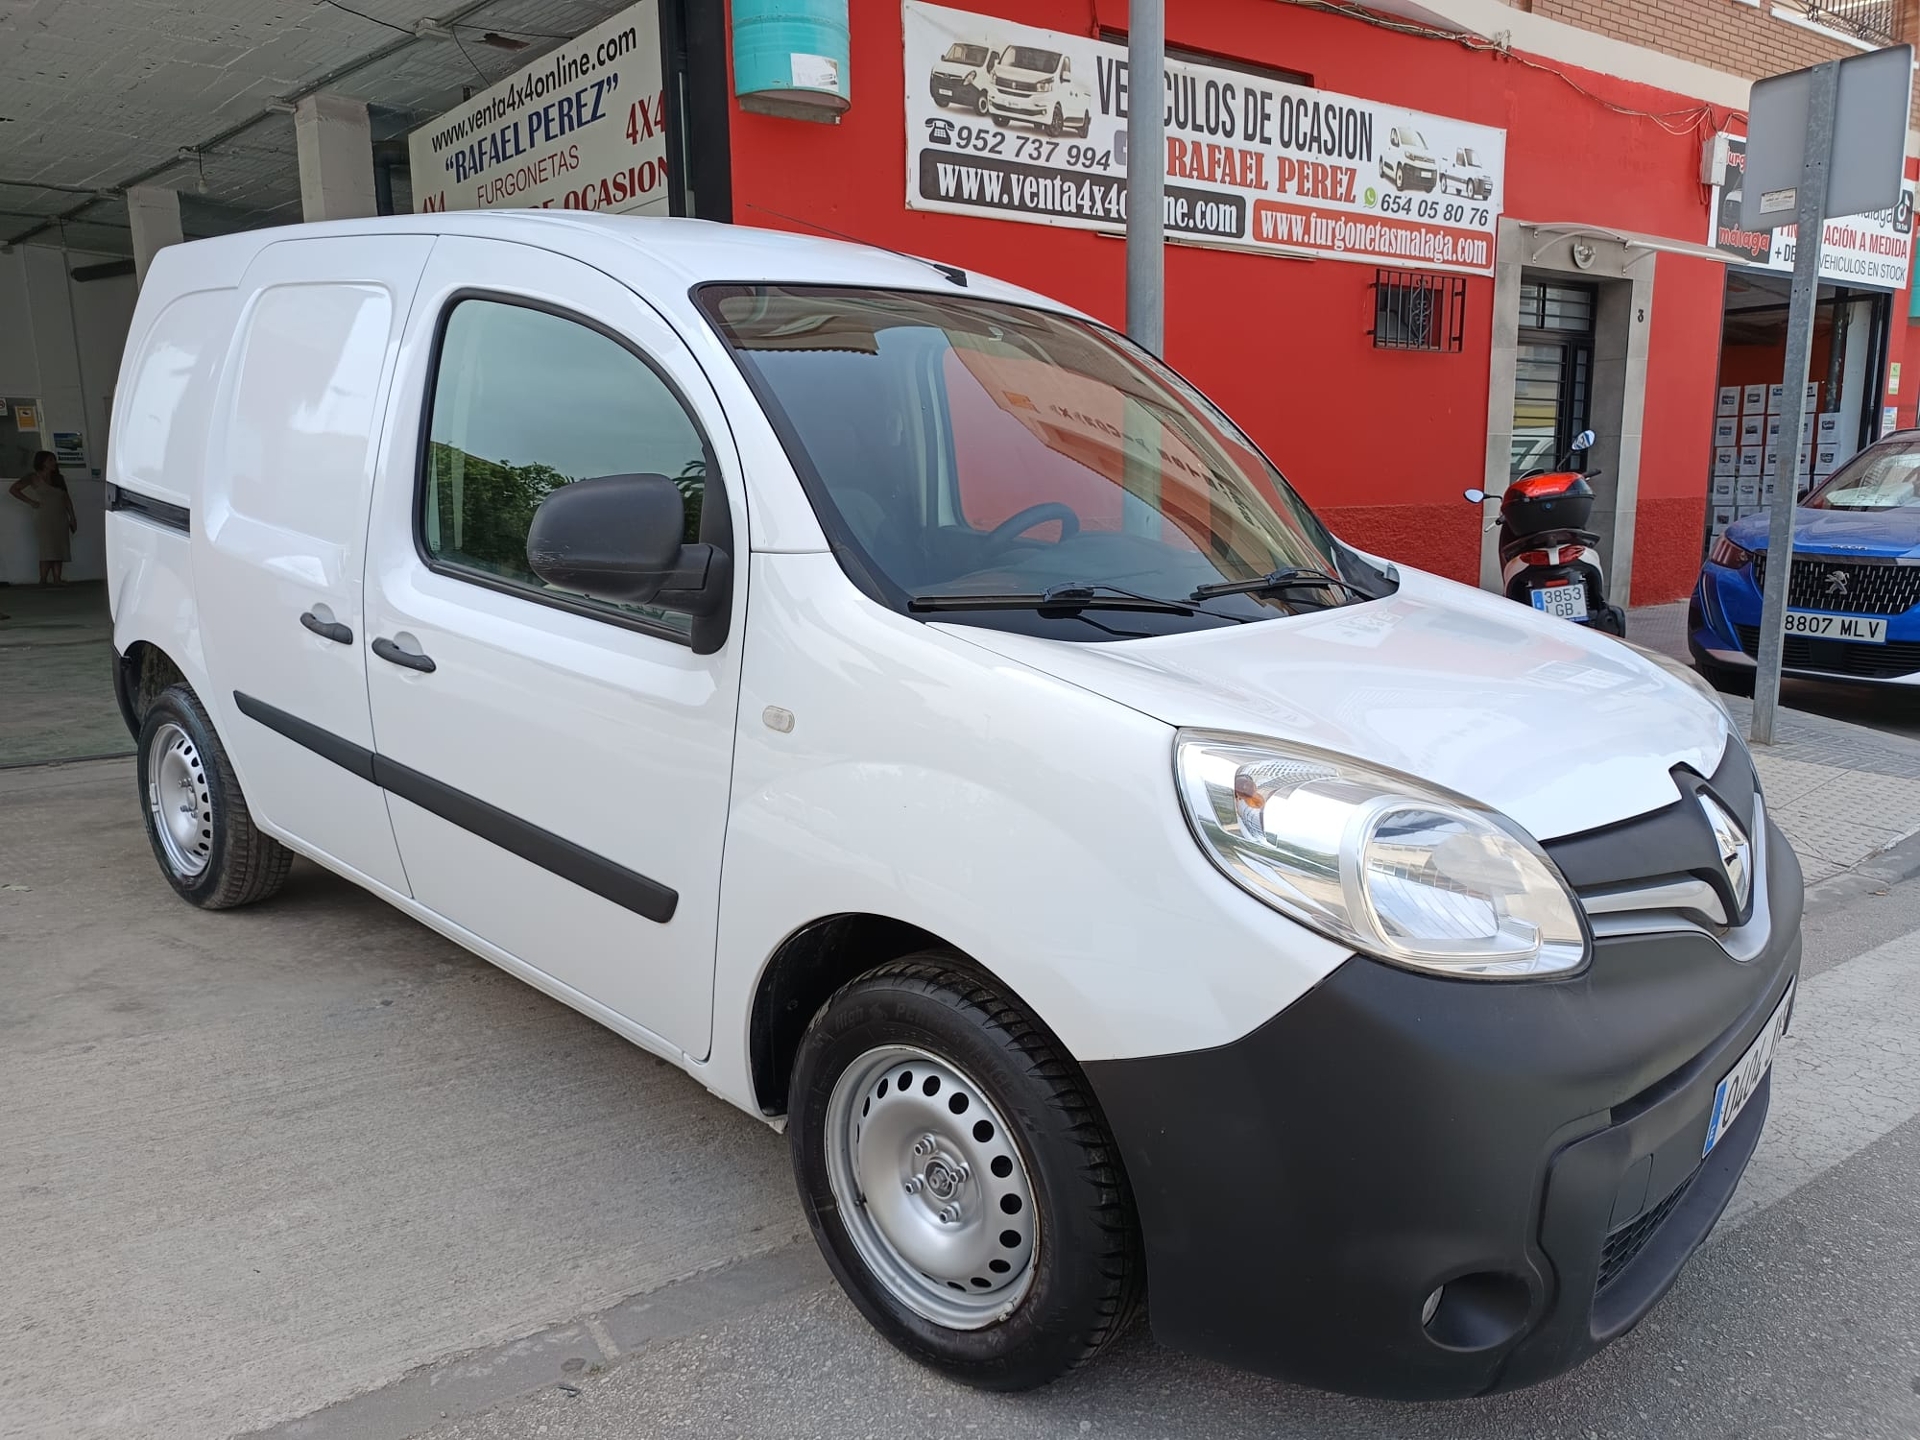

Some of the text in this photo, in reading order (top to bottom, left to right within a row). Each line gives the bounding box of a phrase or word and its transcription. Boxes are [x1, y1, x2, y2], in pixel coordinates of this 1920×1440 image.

[431, 27, 637, 152] www.venta4x4online.com
[1097, 55, 1373, 162] VECULOS DE OCASION
[625, 90, 666, 145] 4X4
[955, 125, 1112, 171] 952 737 994
[1166, 136, 1357, 204] RAFAEL PEREZ
[477, 144, 579, 208] FURGONETAS
[564, 156, 668, 212] OCASION
[936, 162, 1237, 233] www.venta4x4one.com
[1260, 209, 1487, 265] www.furgonetasmalaga.com
[1380, 193, 1489, 227] 654 05 80 76
[1858, 232, 1866, 251] A
[1868, 233, 1907, 259] MEDIDA
[1867, 261, 1879, 277] EN
[1880, 263, 1906, 281] STOCK
[1544, 587, 1582, 604] 3853
[1784, 614, 1880, 639] 8807 MLV
